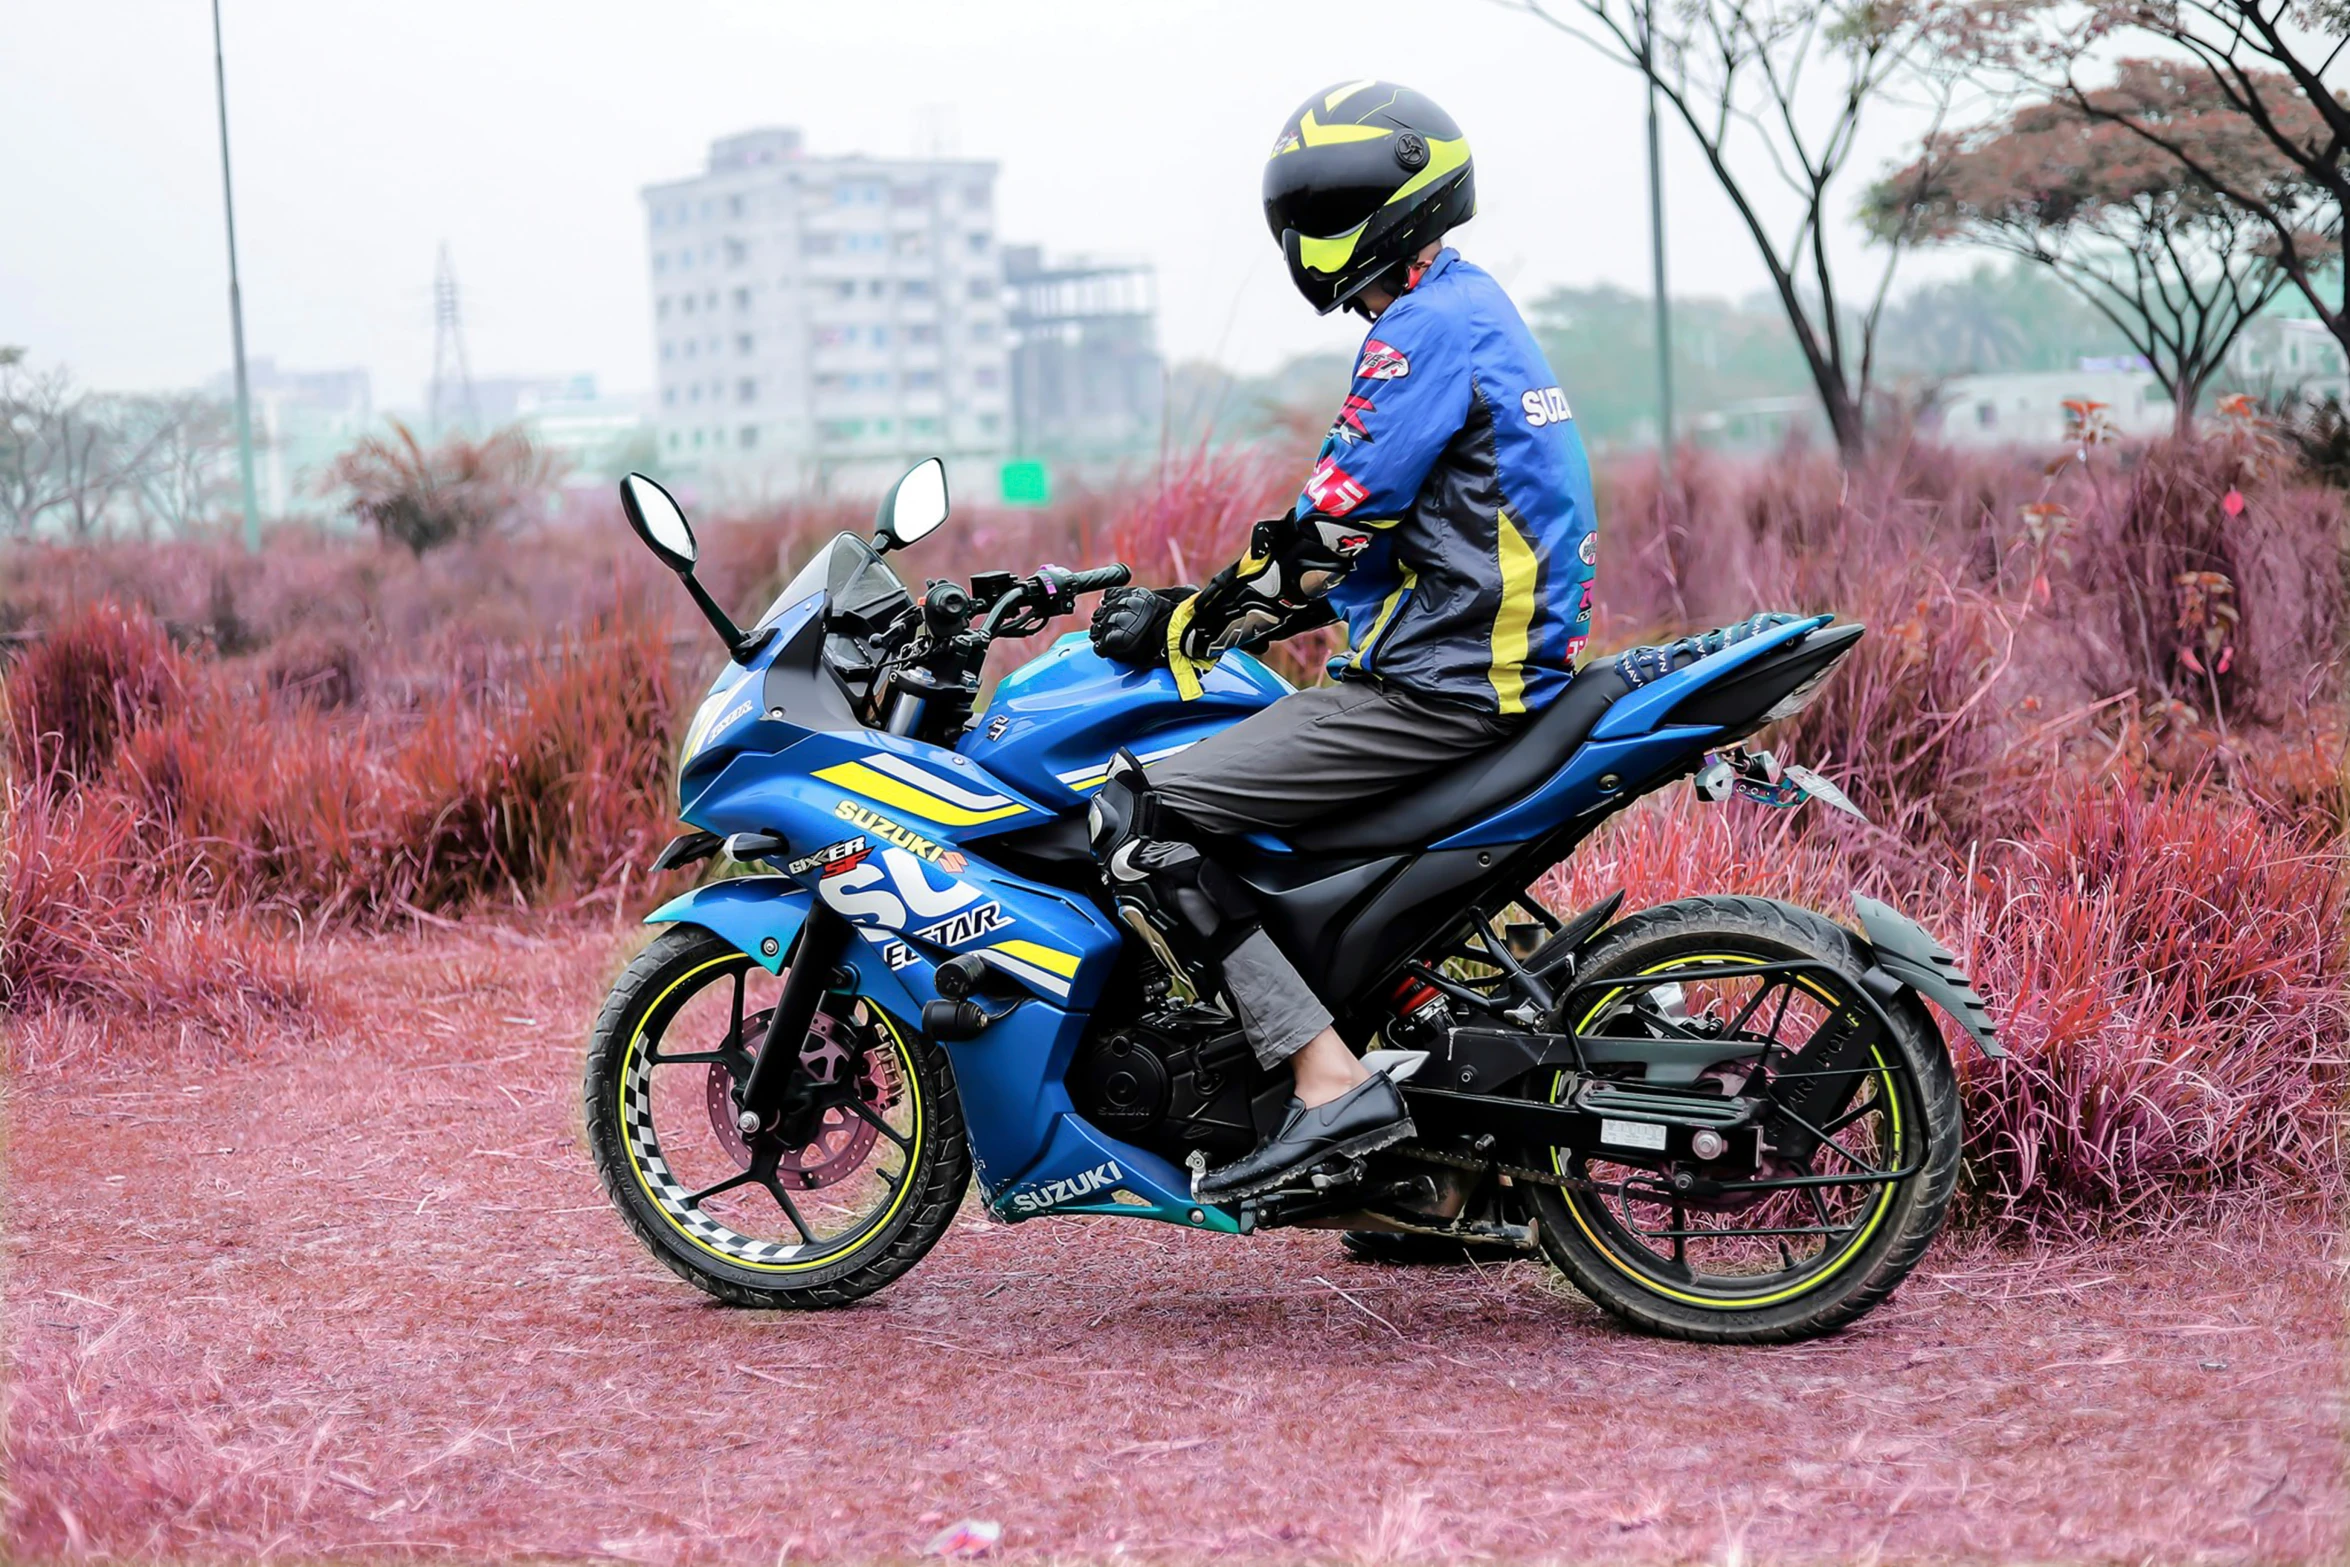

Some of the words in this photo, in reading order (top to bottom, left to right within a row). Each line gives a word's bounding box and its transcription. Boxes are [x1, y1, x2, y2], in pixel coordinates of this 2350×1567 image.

[834, 800, 945, 863] SUZUKI
[788, 835, 866, 875] GIXXER
[821, 848, 874, 879] SF
[1013, 1160, 1123, 1212] SUZUKI
